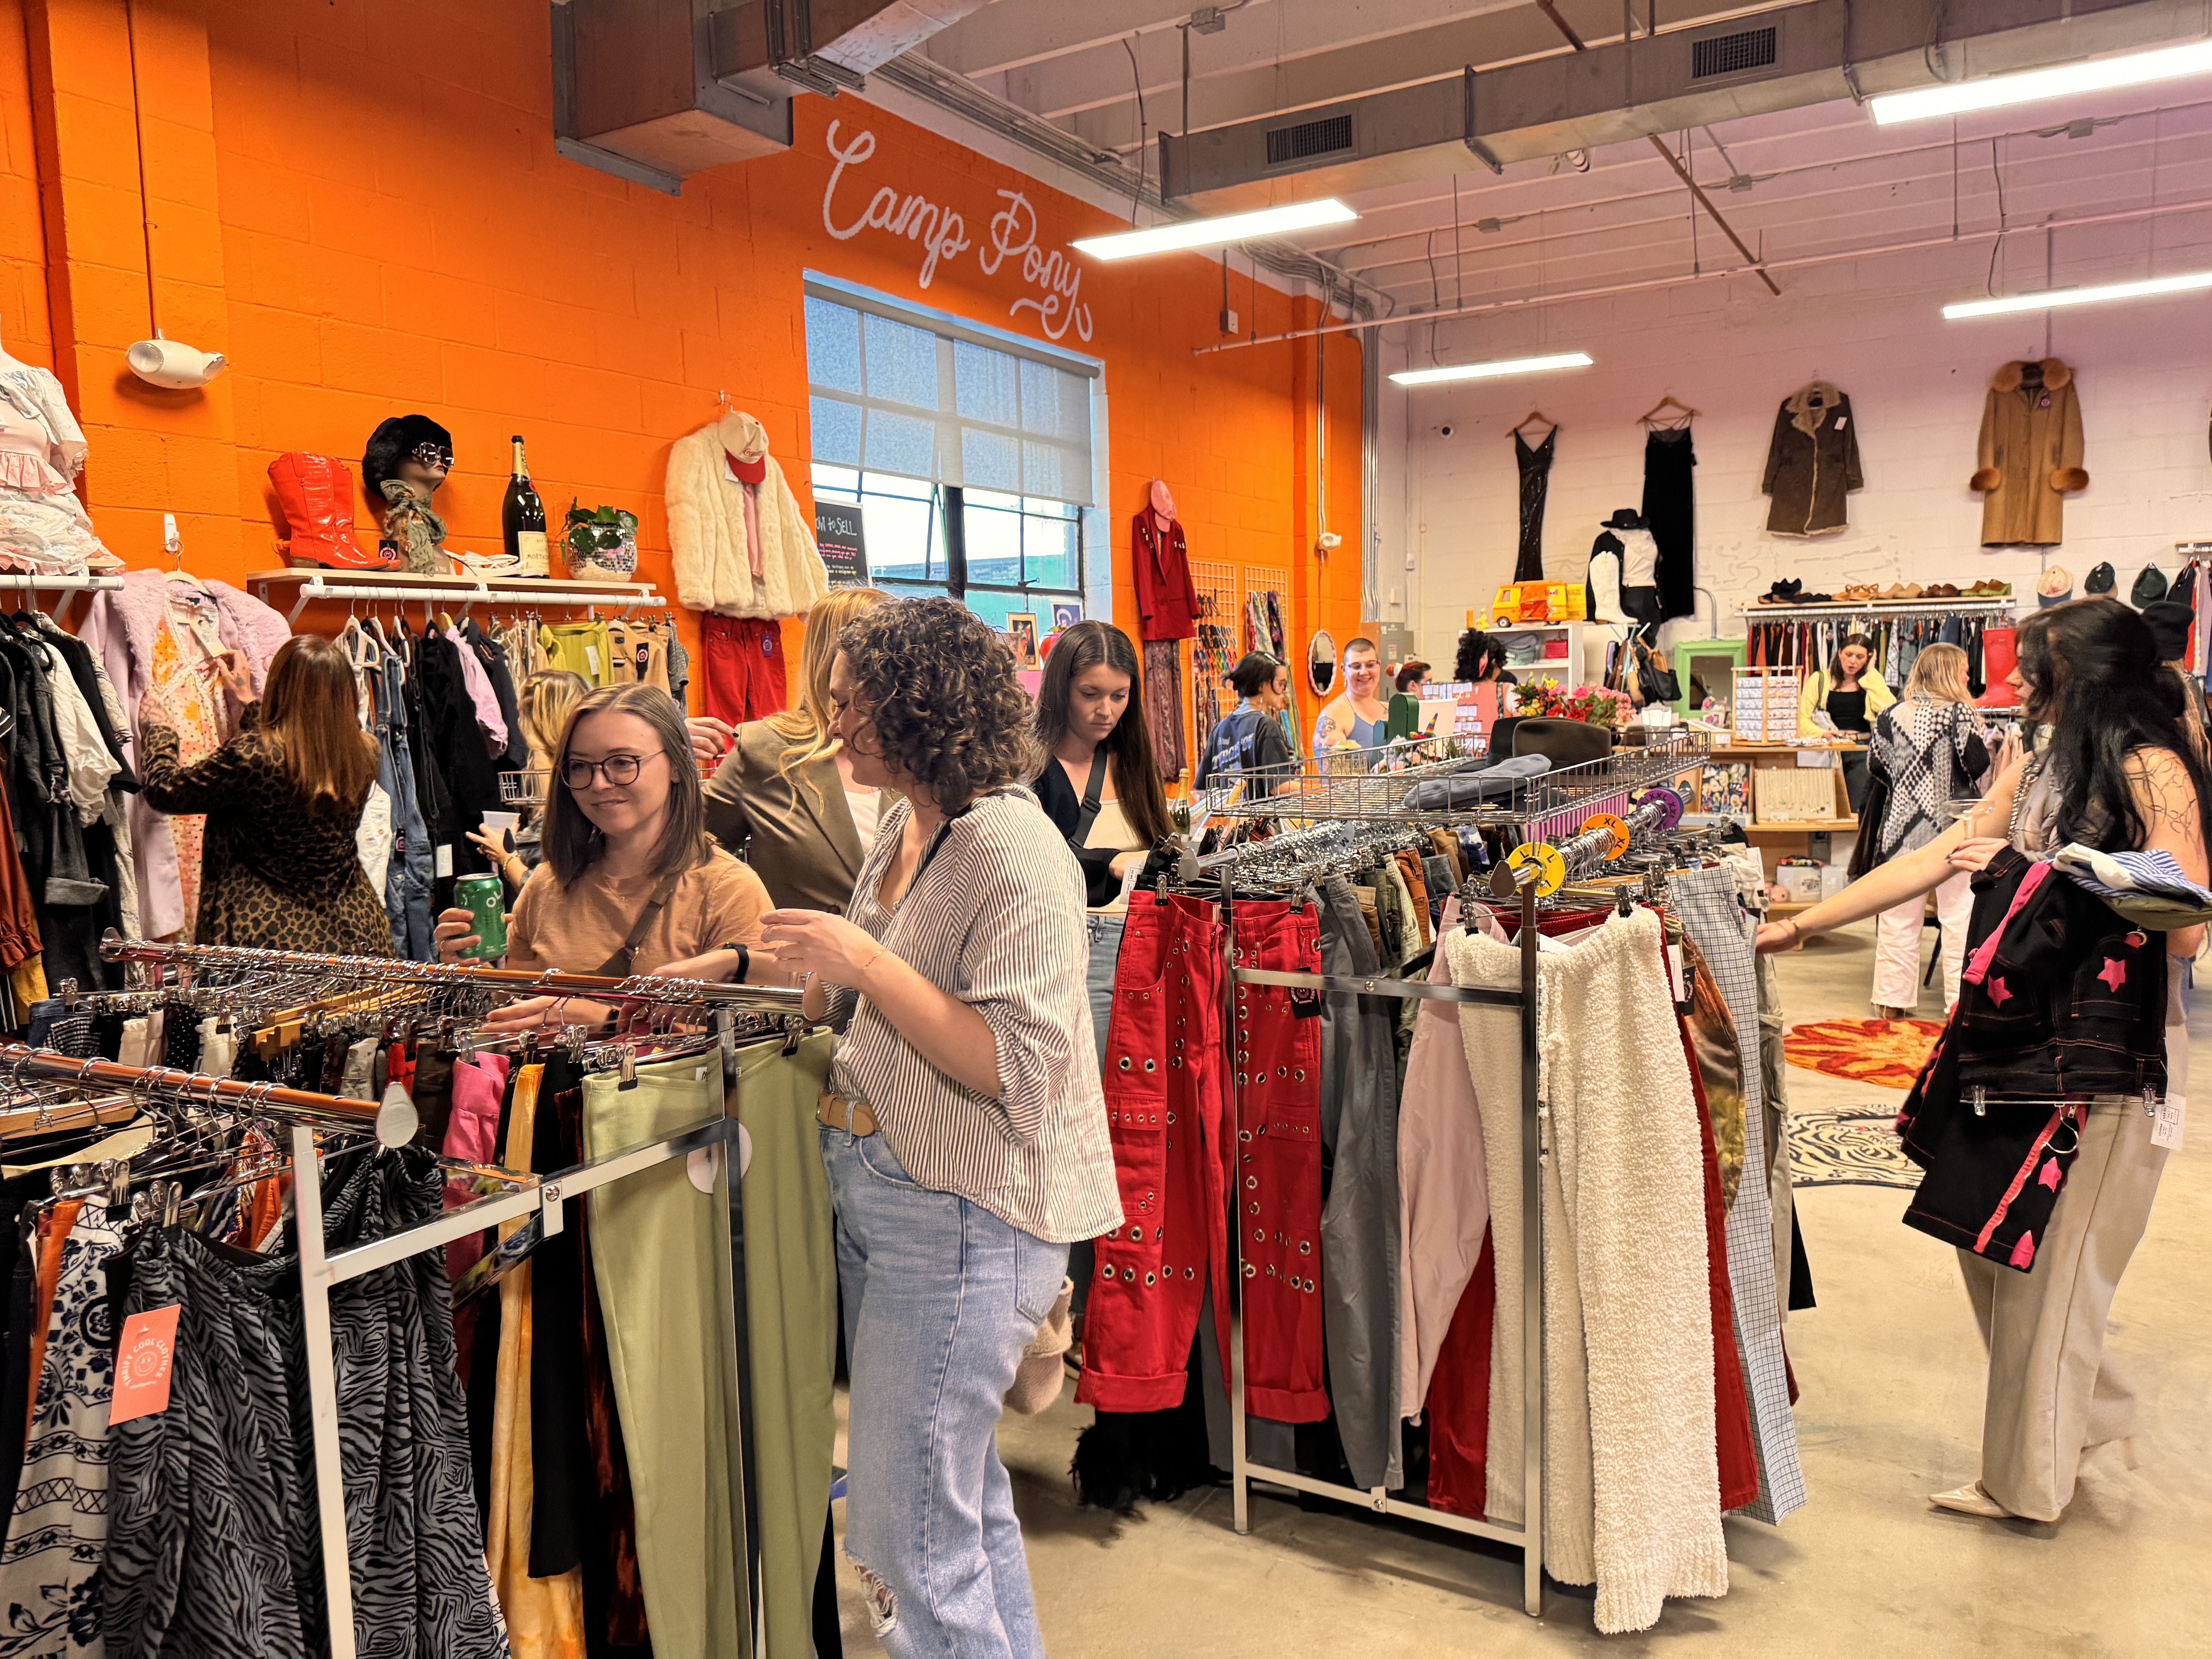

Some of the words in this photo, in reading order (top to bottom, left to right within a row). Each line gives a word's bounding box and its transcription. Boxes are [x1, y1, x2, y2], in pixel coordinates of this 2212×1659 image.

[823, 119, 970, 289] Camp
[979, 189, 1093, 342] Pony
[816, 516, 826, 532] OW
[835, 517, 857, 536] SELL
[1604, 817, 1616, 828] XL
[1340, 837, 1349, 847] M
[1614, 837, 1626, 849] XL
[1519, 850, 1529, 859] L
[1547, 854, 1555, 863] L
[133, 1338, 155, 1353] COOL
[156, 1340, 169, 1378] CLOTHES
